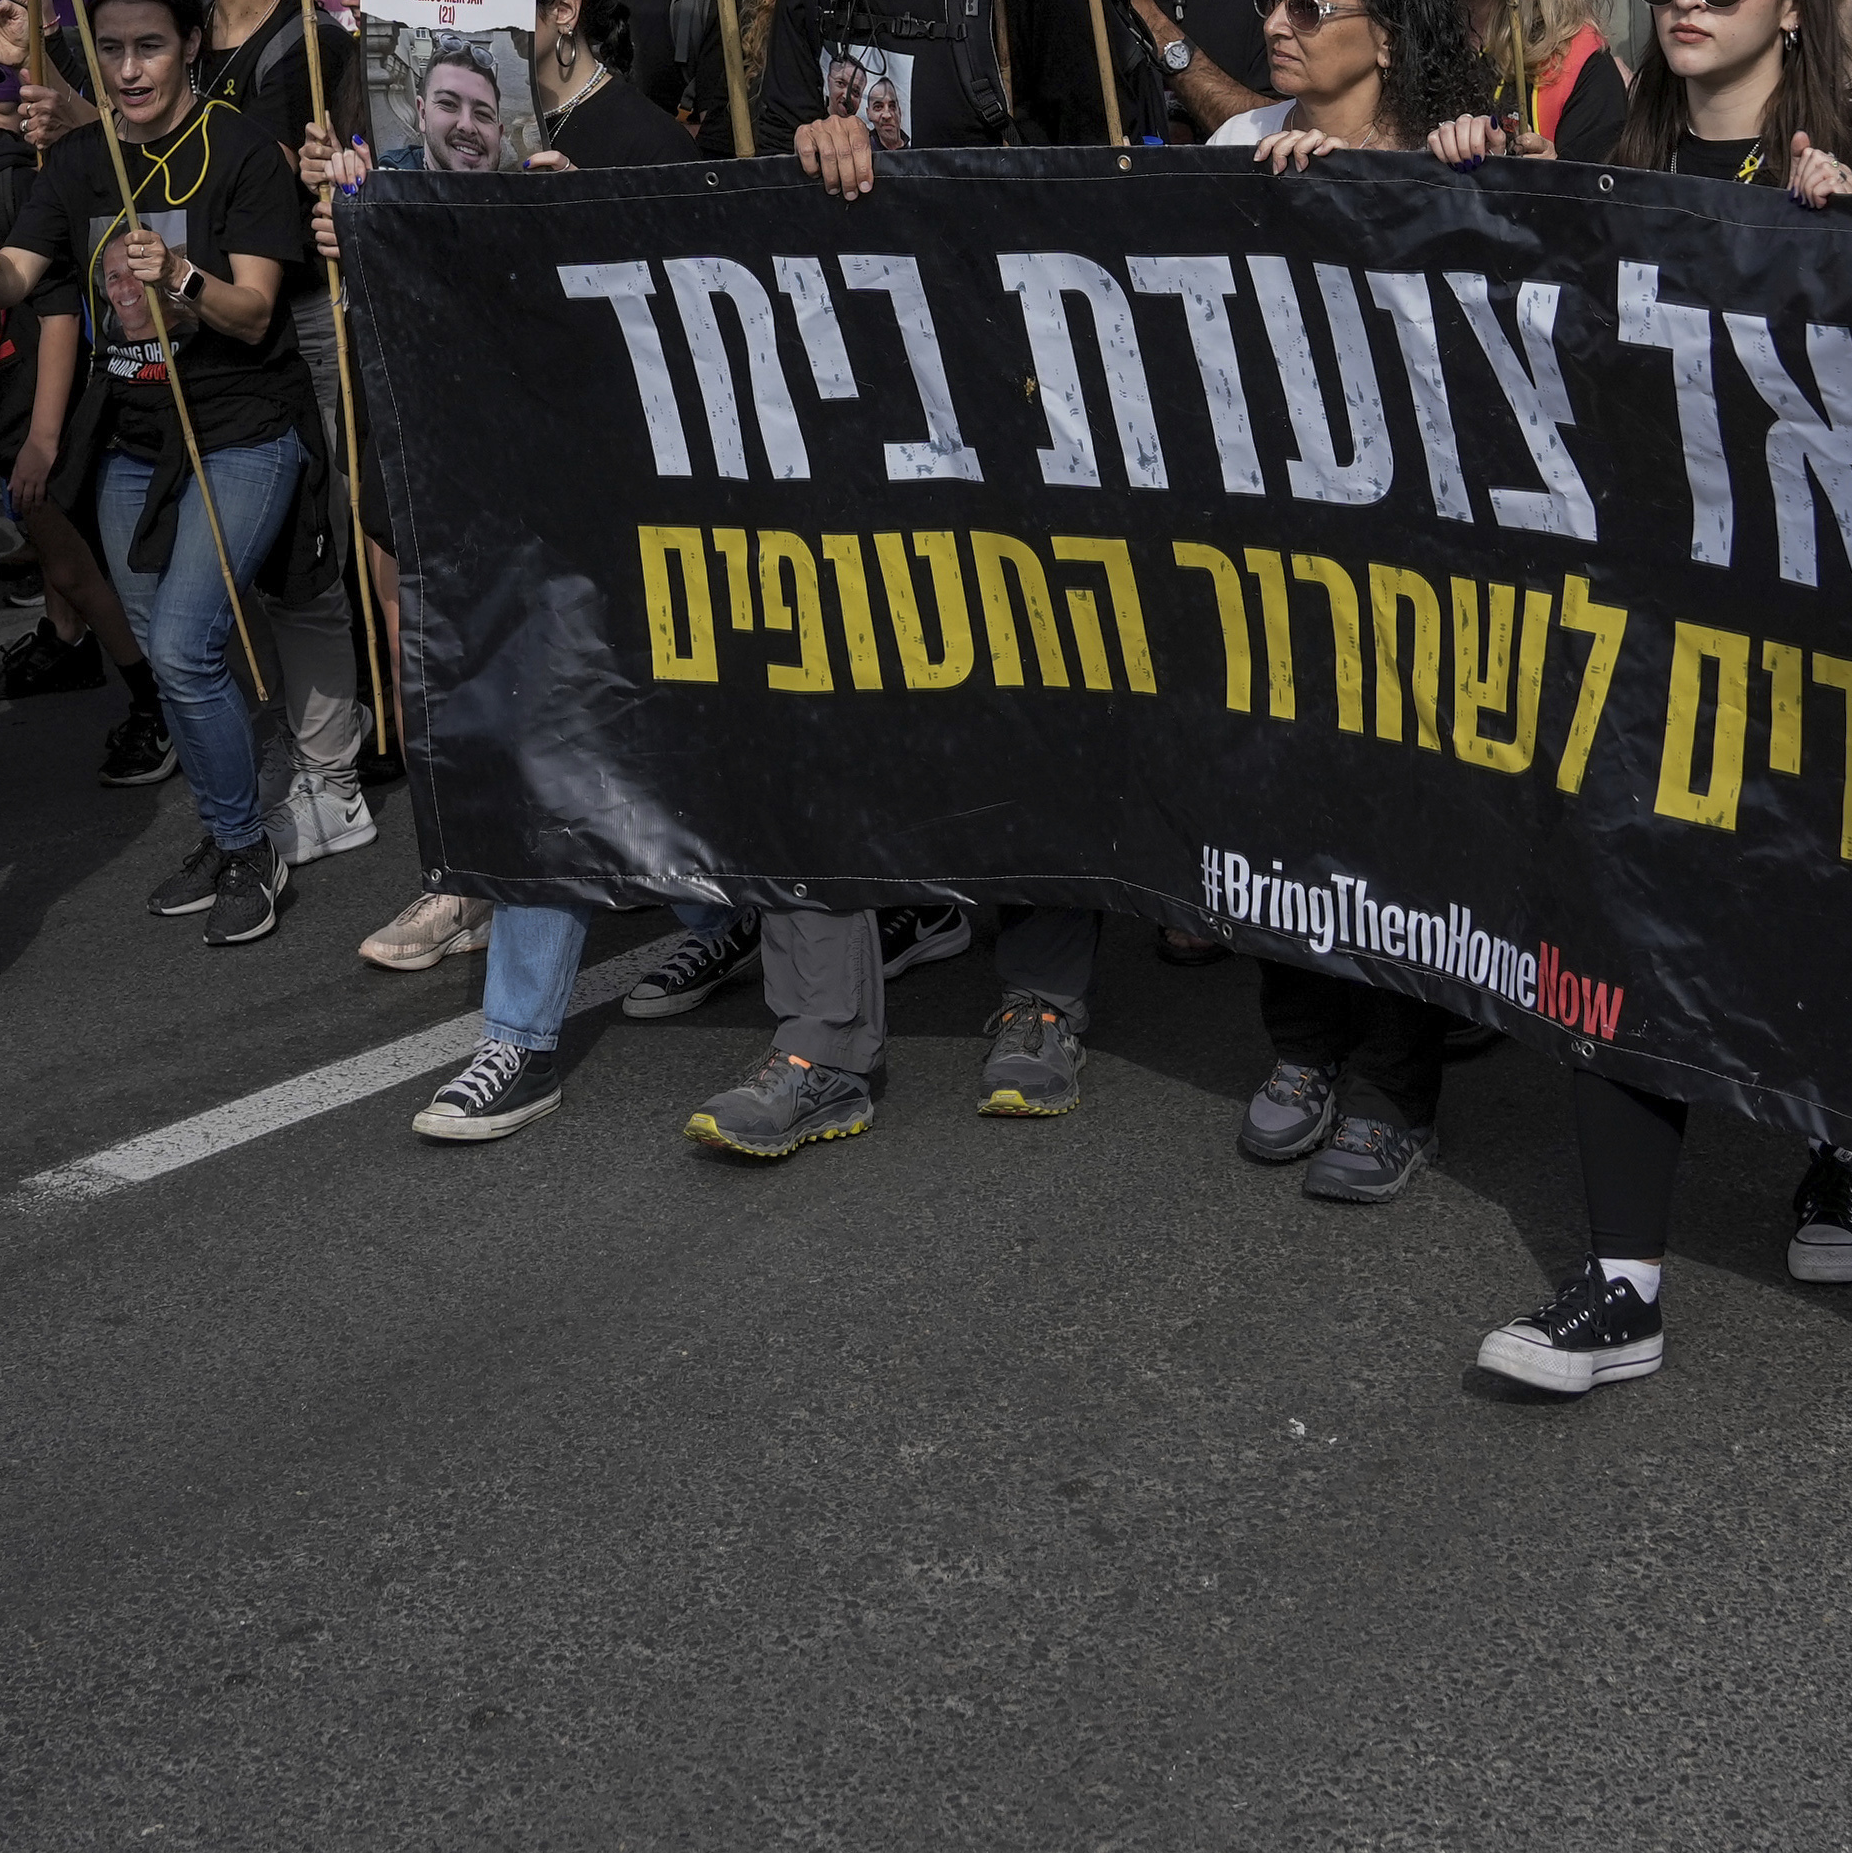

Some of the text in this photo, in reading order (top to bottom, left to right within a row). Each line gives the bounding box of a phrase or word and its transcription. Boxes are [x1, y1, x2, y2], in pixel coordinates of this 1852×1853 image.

[438, 6, 456, 25] (21)
[556, 252, 987, 483] ביחד
[999, 249, 1598, 542] צועדת
[635, 523, 1630, 794] לשחרור החטופים
[1199, 842, 1627, 1046] #BringThemHomeNow
